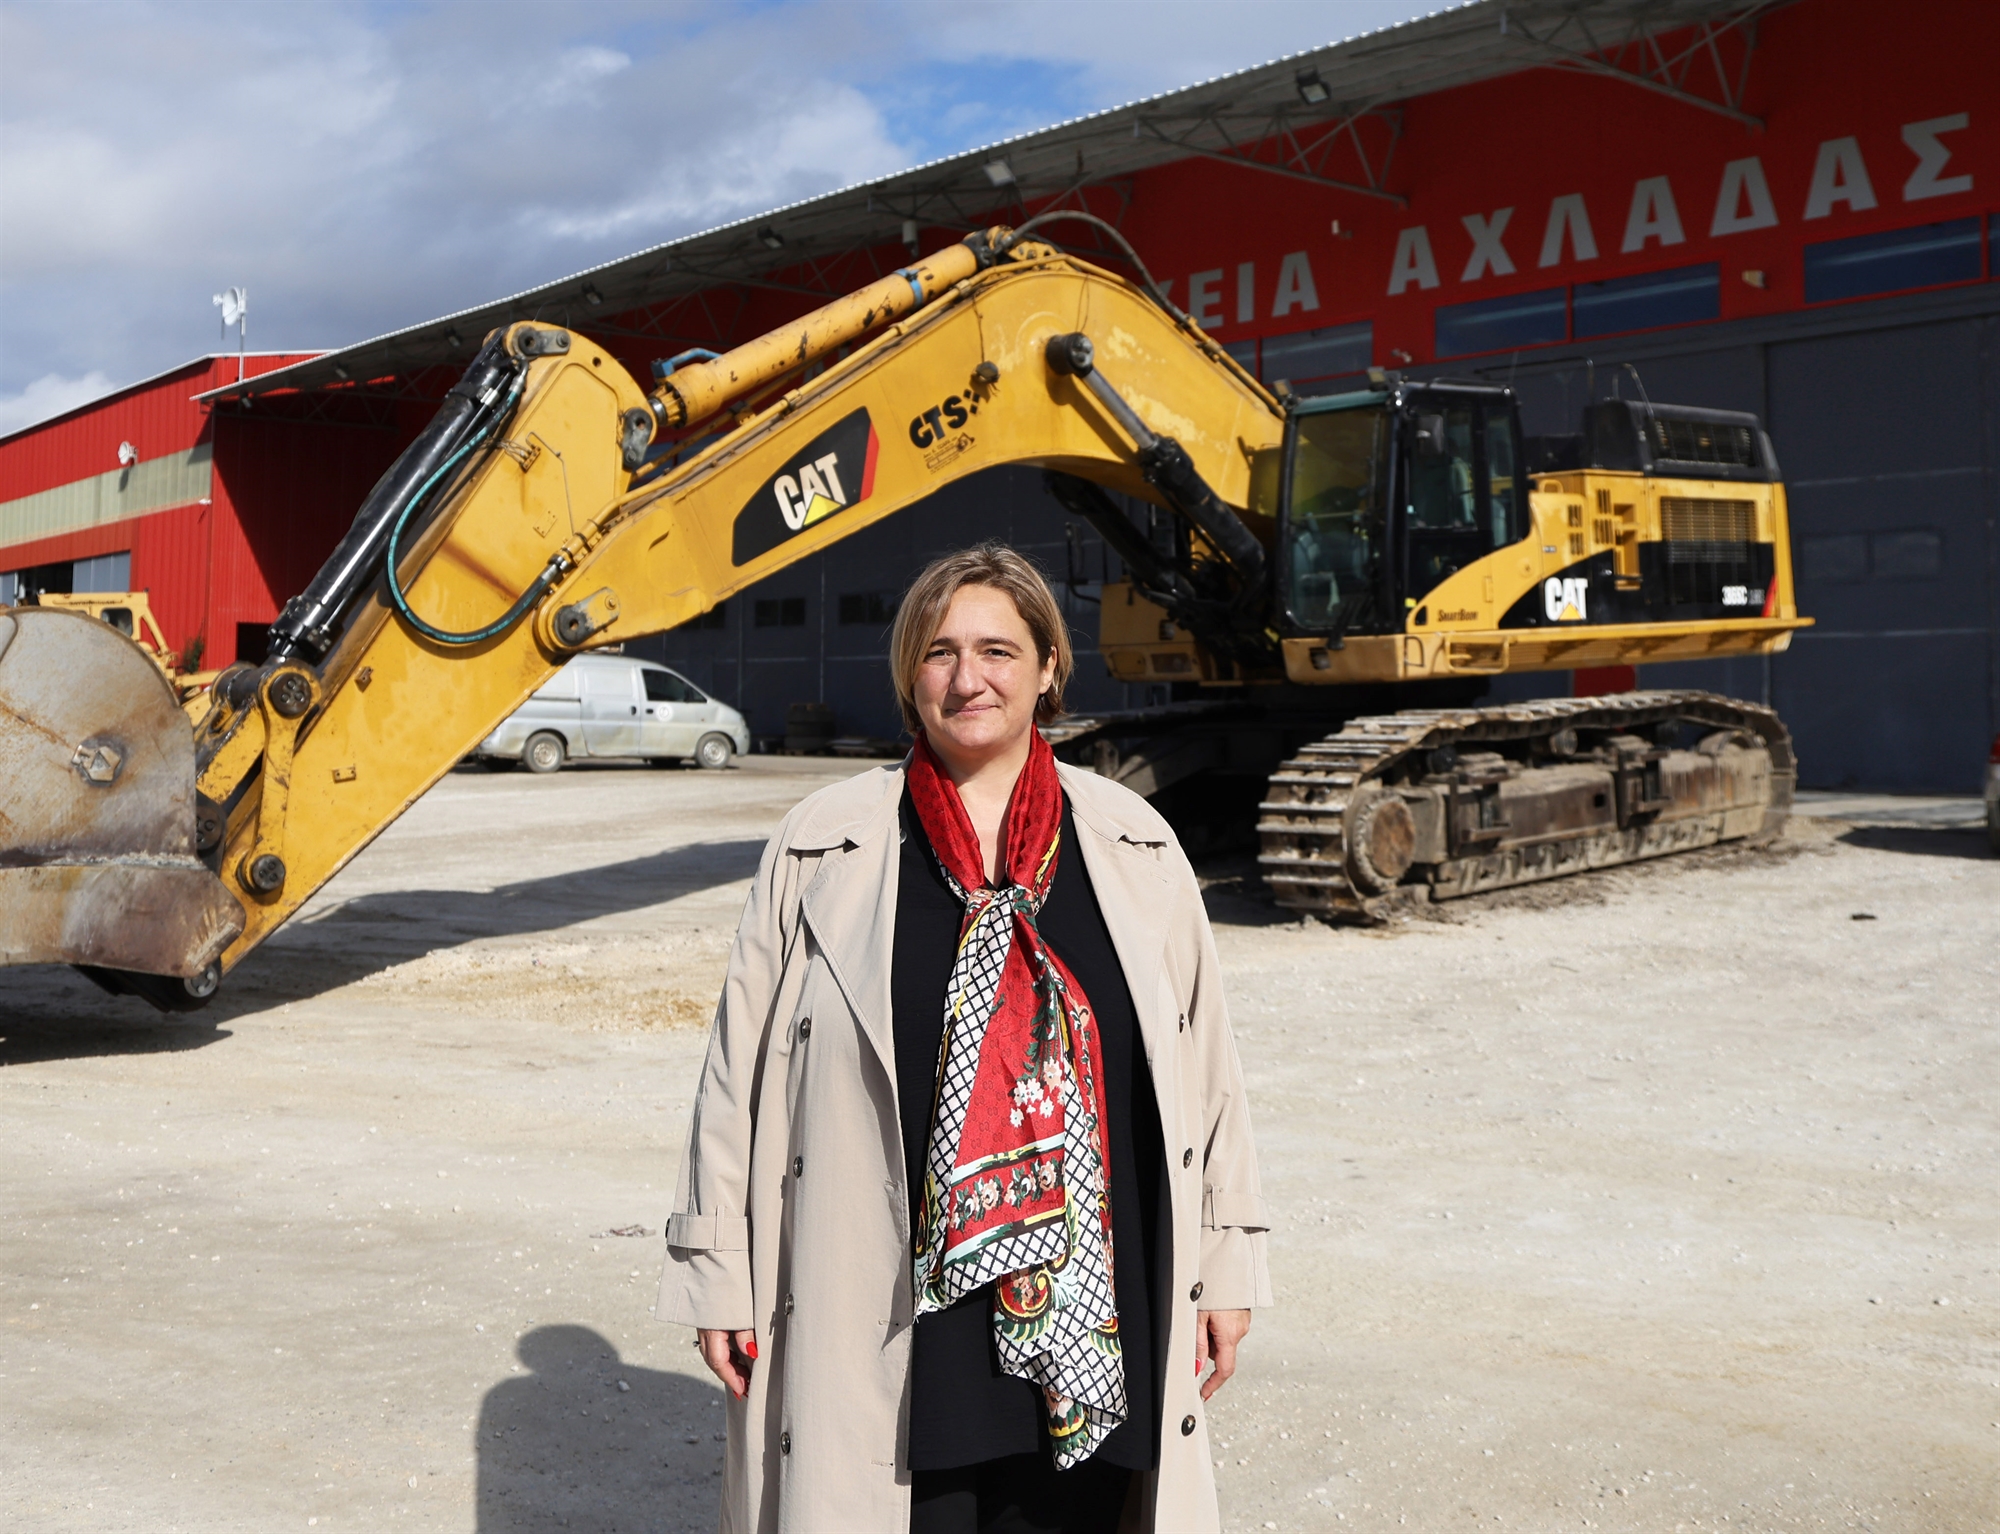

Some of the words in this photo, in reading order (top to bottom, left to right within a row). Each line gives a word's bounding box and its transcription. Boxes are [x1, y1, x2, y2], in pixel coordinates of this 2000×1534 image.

[1387, 112, 1974, 296] ΑΧΛΑΔΑΣ
[909, 395, 970, 449] GTS
[773, 452, 847, 531] CAT
[1544, 576, 1588, 621] CAT
